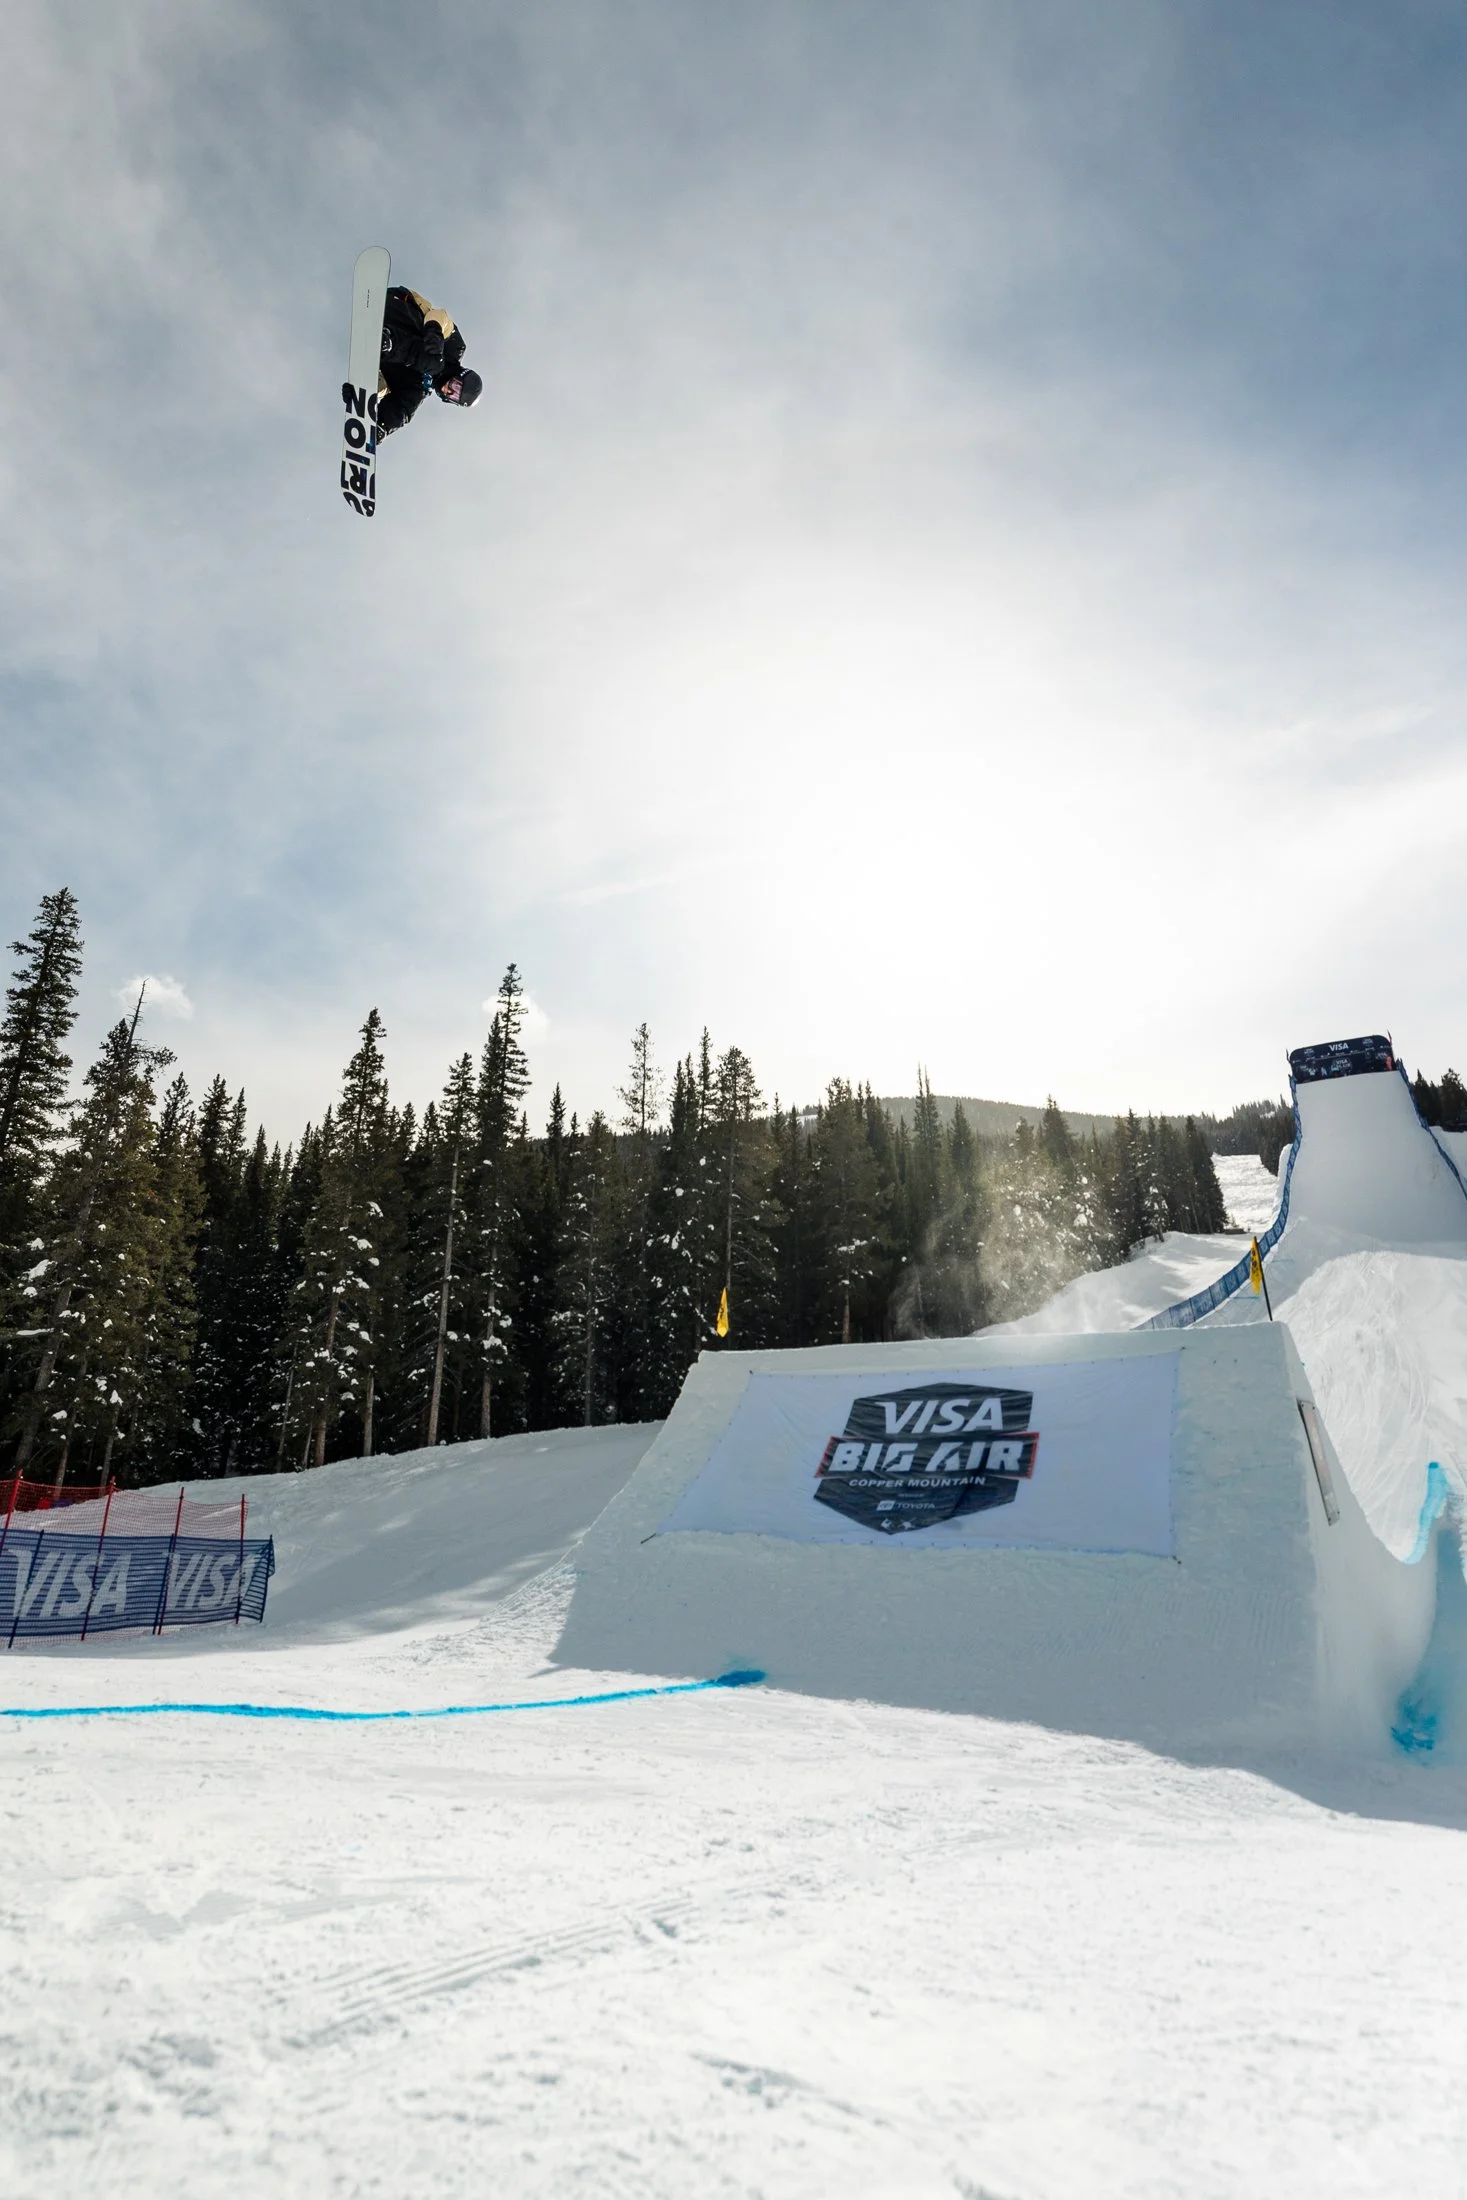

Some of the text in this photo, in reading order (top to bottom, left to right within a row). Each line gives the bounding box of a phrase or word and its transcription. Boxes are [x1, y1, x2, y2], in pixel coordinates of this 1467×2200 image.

[1328, 1042, 1349, 1052] VISA
[874, 1397, 1004, 1435] VISA
[829, 1440, 1025, 1473] BIG AIR
[848, 1475, 986, 1488] COPPER MOUNTAIN
[896, 1502, 936, 1510] TOYOTA
[5, 1549, 132, 1619] VISA
[162, 1551, 257, 1611] VISA
